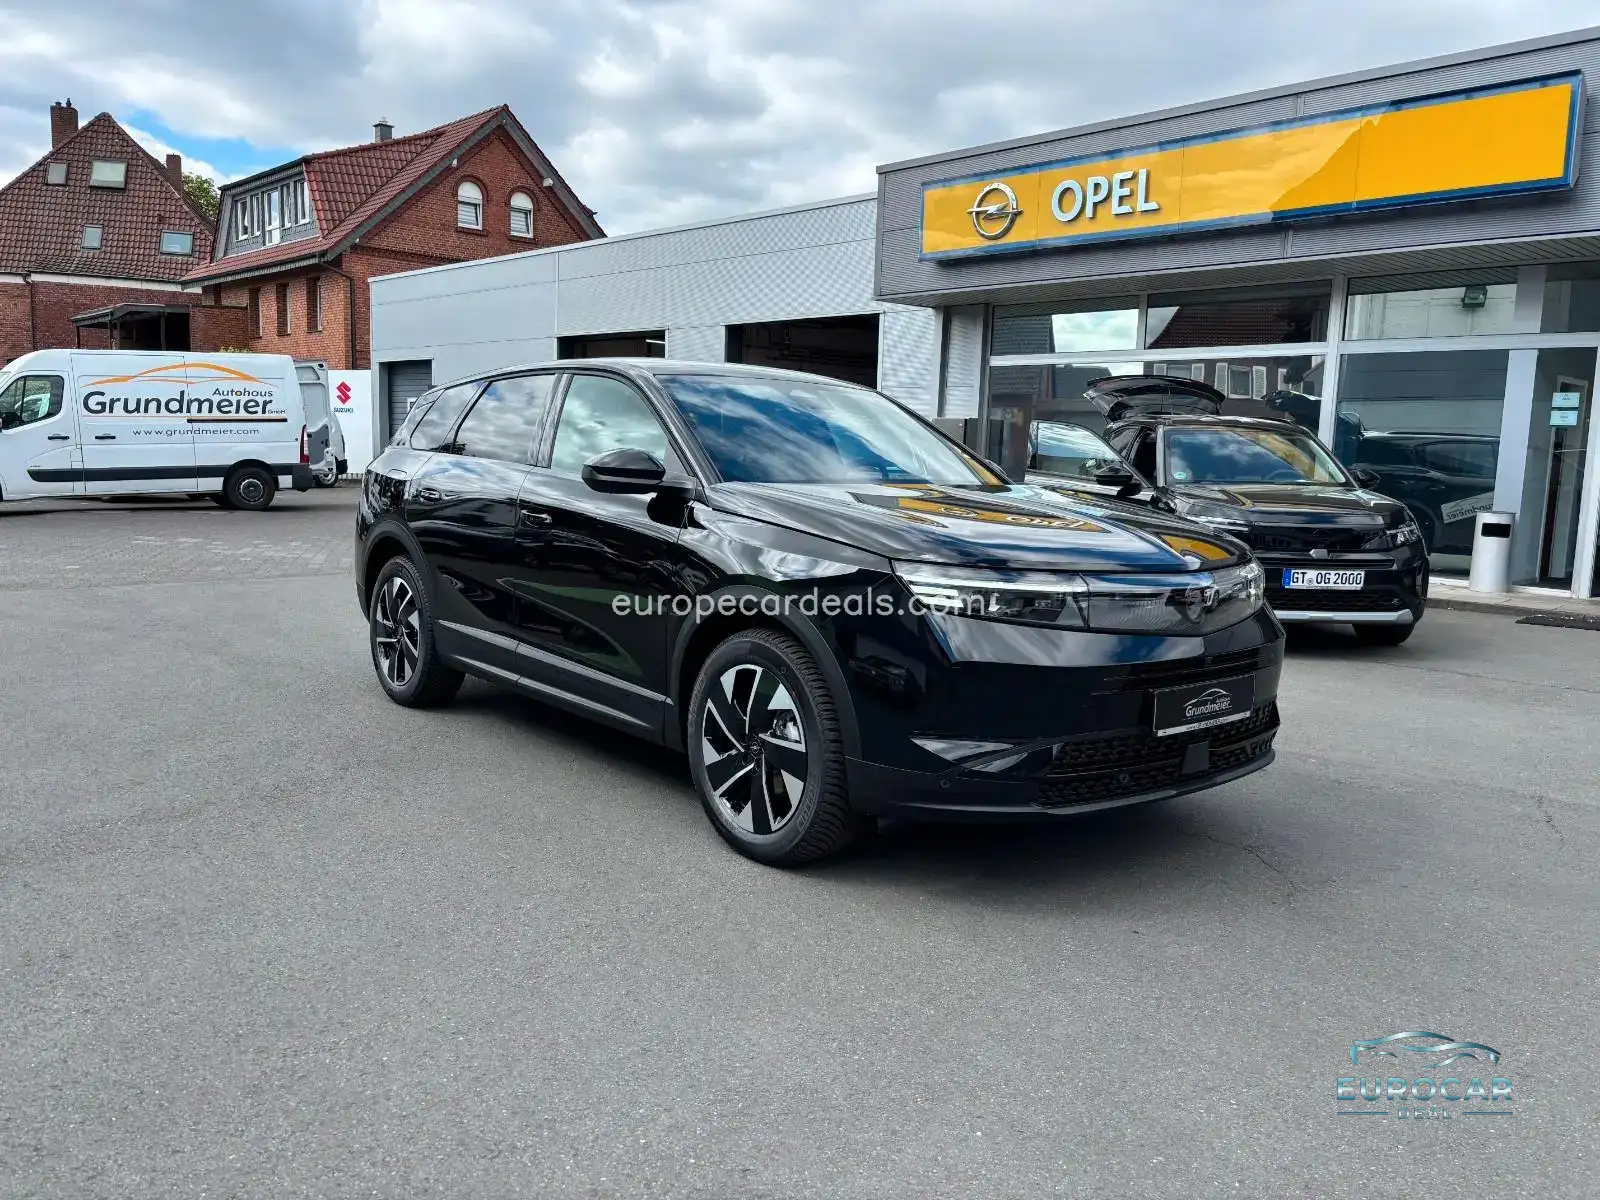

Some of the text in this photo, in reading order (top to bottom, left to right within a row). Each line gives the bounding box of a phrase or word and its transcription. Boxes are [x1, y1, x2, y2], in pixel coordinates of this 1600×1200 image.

[1051, 168, 1160, 222] OPEL
[212, 388, 273, 397] Autohaus
[83, 391, 273, 415] Grundmeier
[132, 428, 260, 437] www.grundmeier.com
[1292, 572, 1362, 585] GT OG 2000
[1186, 700, 1230, 717] Grundmeier
